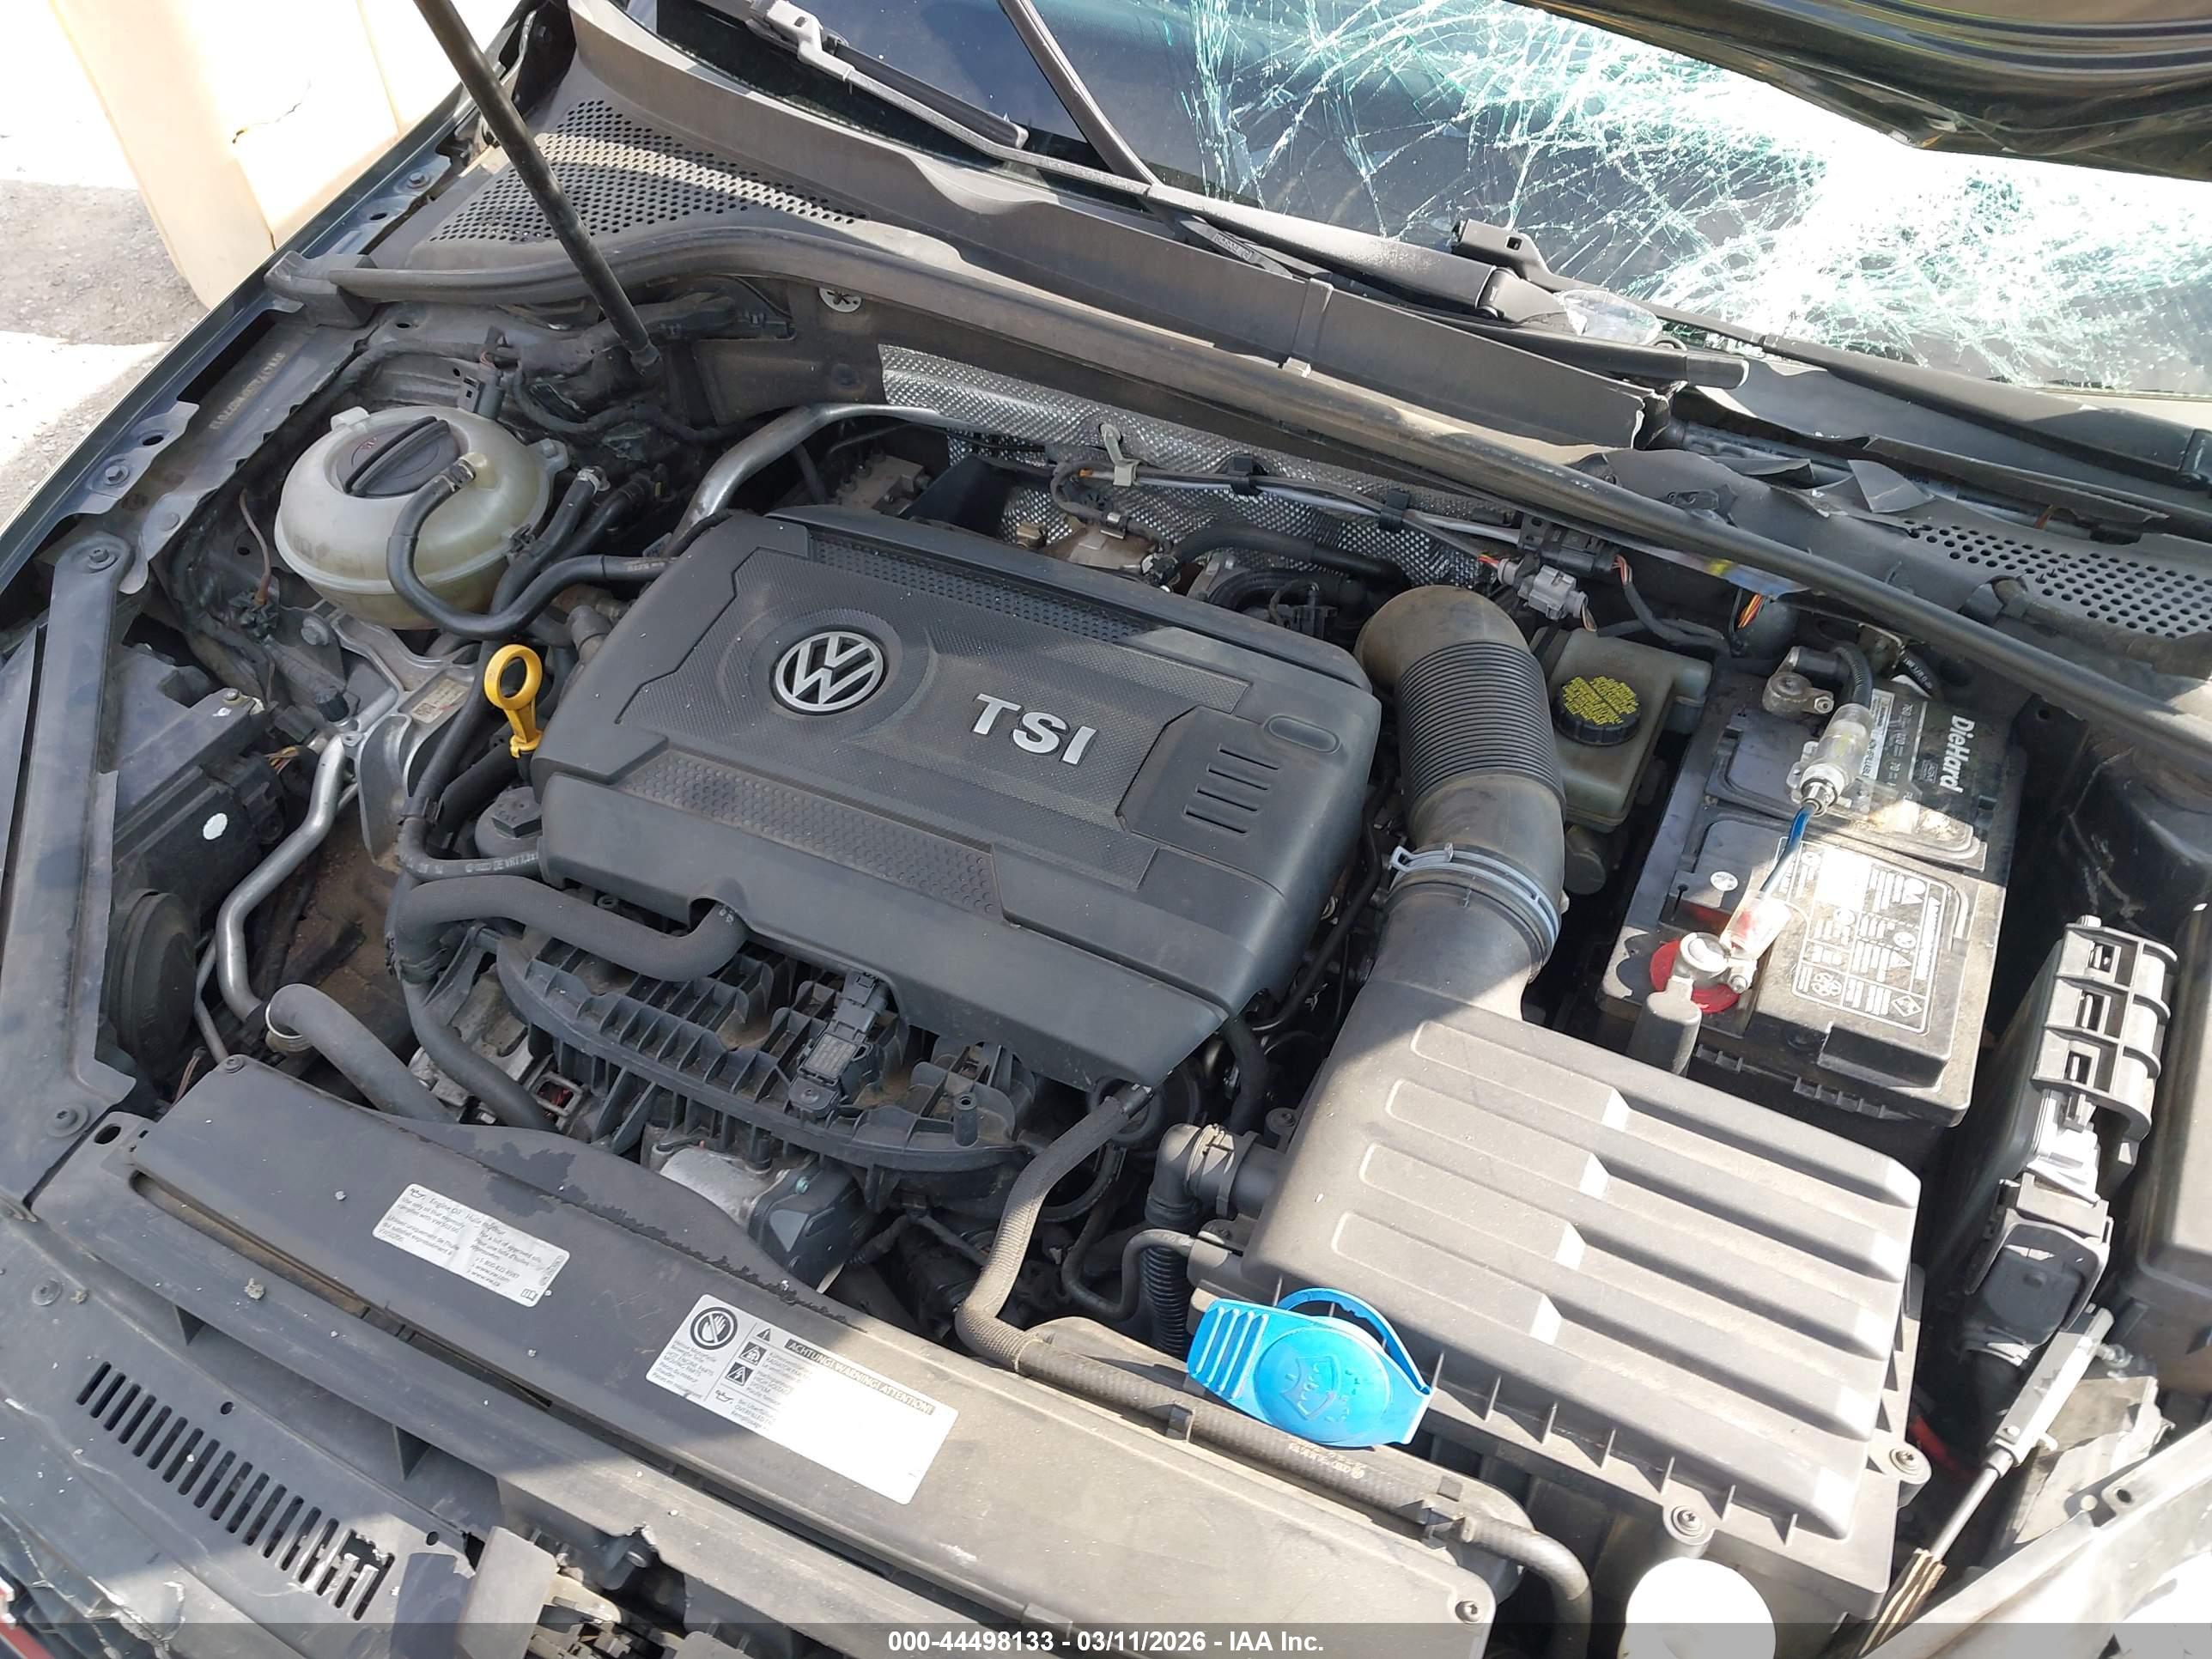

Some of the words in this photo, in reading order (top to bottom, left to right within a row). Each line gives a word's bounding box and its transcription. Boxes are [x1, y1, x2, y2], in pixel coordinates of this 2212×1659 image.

[972, 693, 1098, 766] TSI
[1940, 714, 1976, 793] DieHard
[787, 1338, 836, 1369] ACHTUNG!
